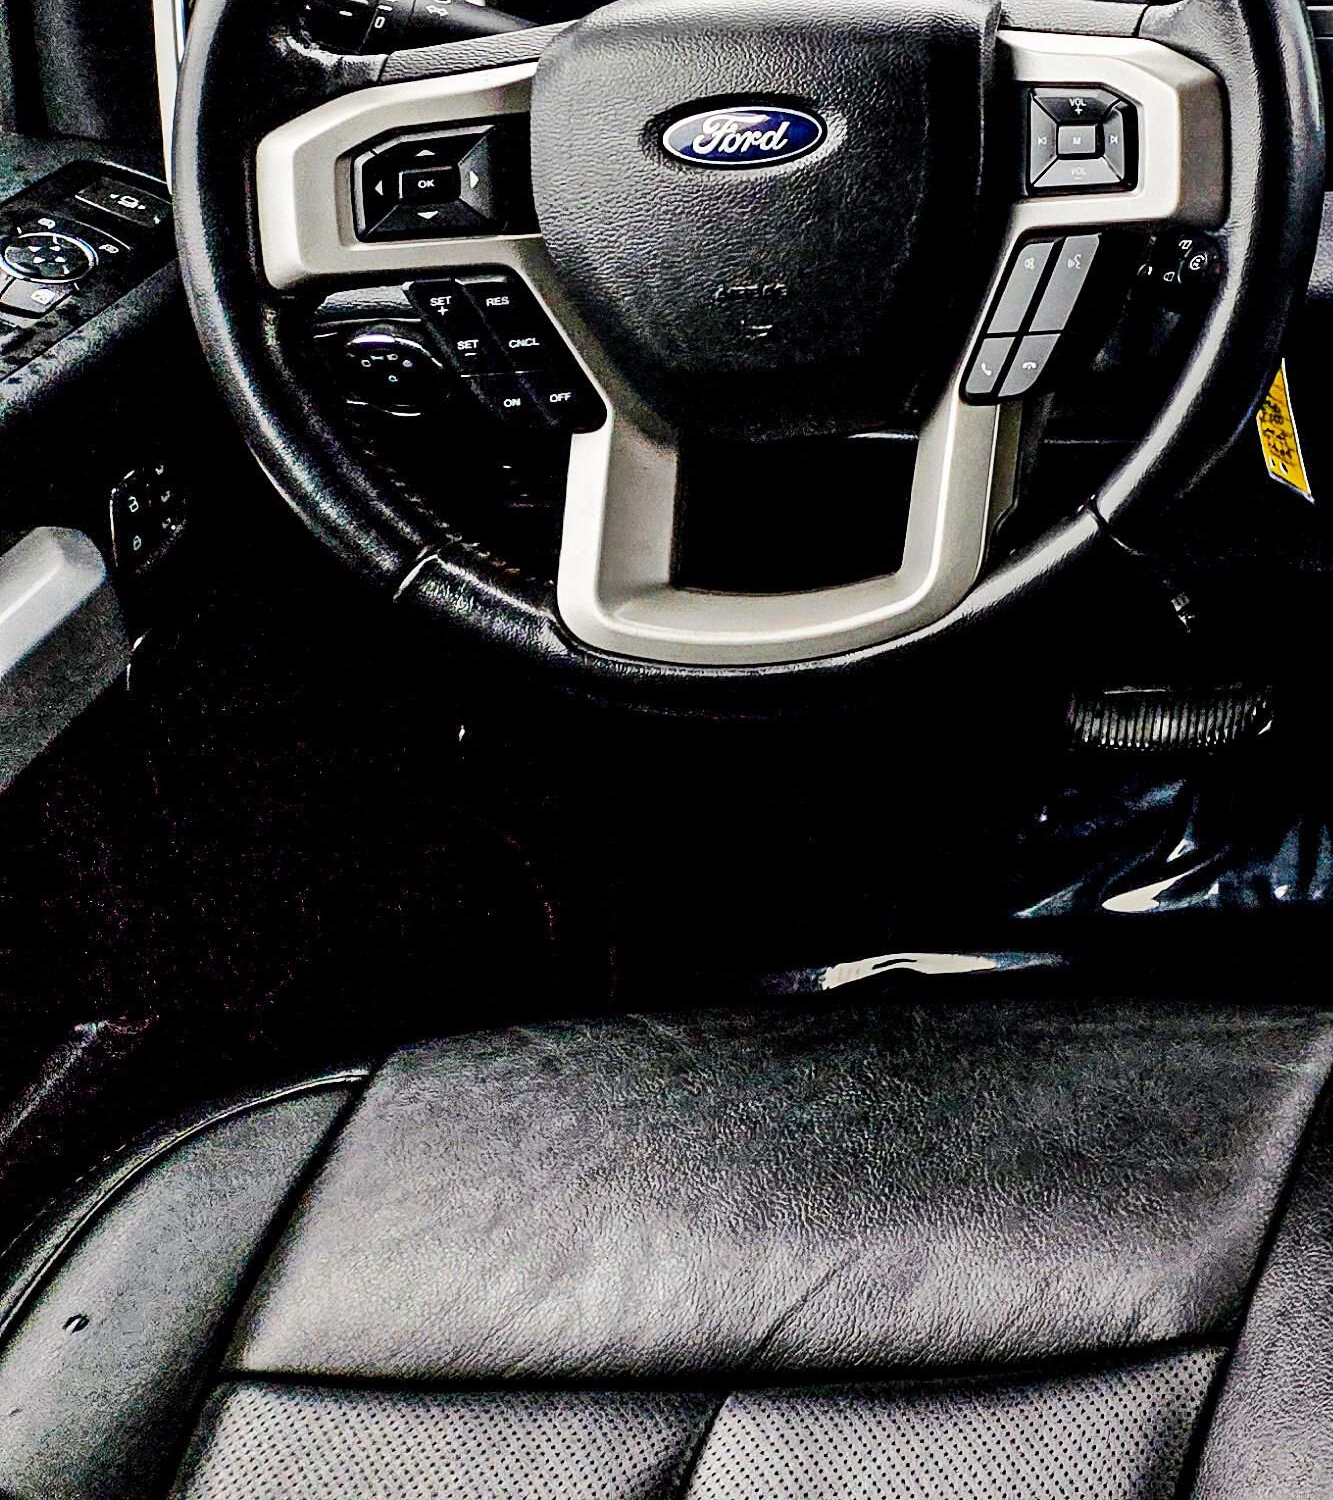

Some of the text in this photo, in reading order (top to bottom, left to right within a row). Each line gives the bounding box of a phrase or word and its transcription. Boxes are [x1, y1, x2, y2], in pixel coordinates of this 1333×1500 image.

[1069, 97, 1087, 107] VOL
[693, 113, 791, 155] Ford
[418, 178, 435, 188] OK
[430, 296, 452, 307] SET
[486, 296, 510, 307] RES
[457, 339, 479, 350] SET
[508, 337, 540, 349] CNCL
[503, 397, 521, 408] ON
[549, 391, 572, 403] OFF
